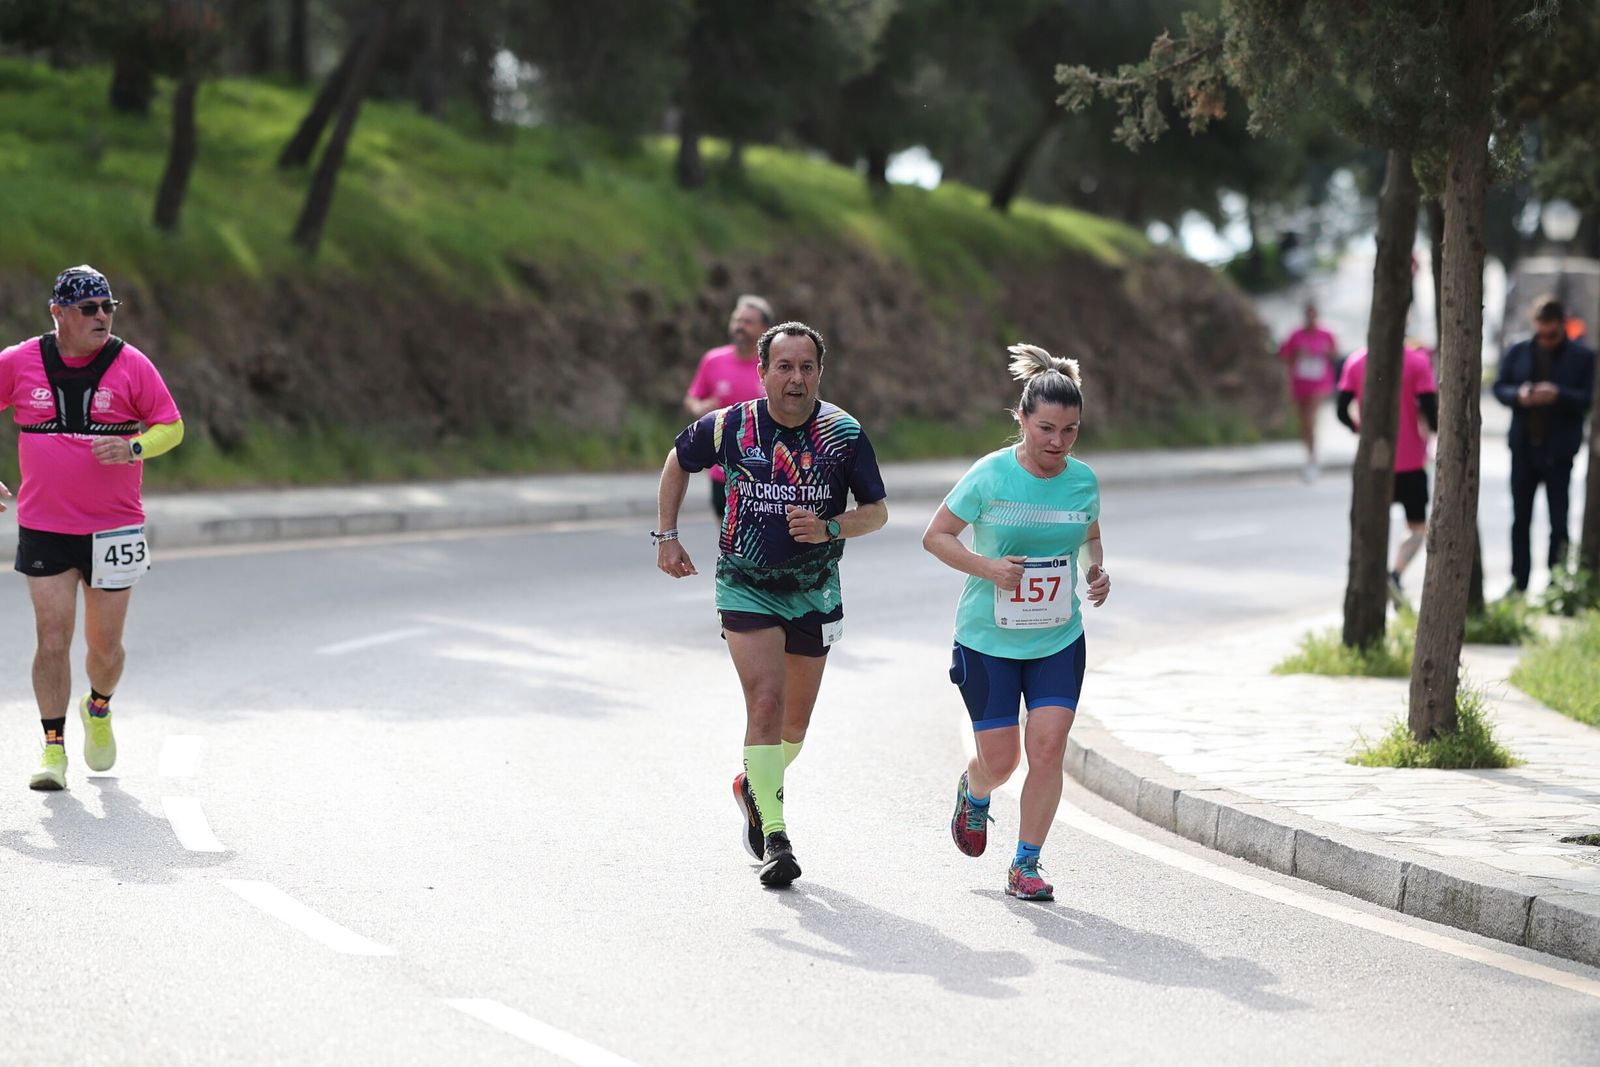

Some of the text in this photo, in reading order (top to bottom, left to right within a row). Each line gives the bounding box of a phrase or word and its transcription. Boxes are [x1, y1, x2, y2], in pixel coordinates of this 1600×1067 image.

[755, 483, 796, 501] CROSS
[799, 484, 832, 501] TRAIL
[753, 501, 783, 515] CAÑETE
[104, 541, 145, 567] 453
[1010, 576, 1061, 603] 157
